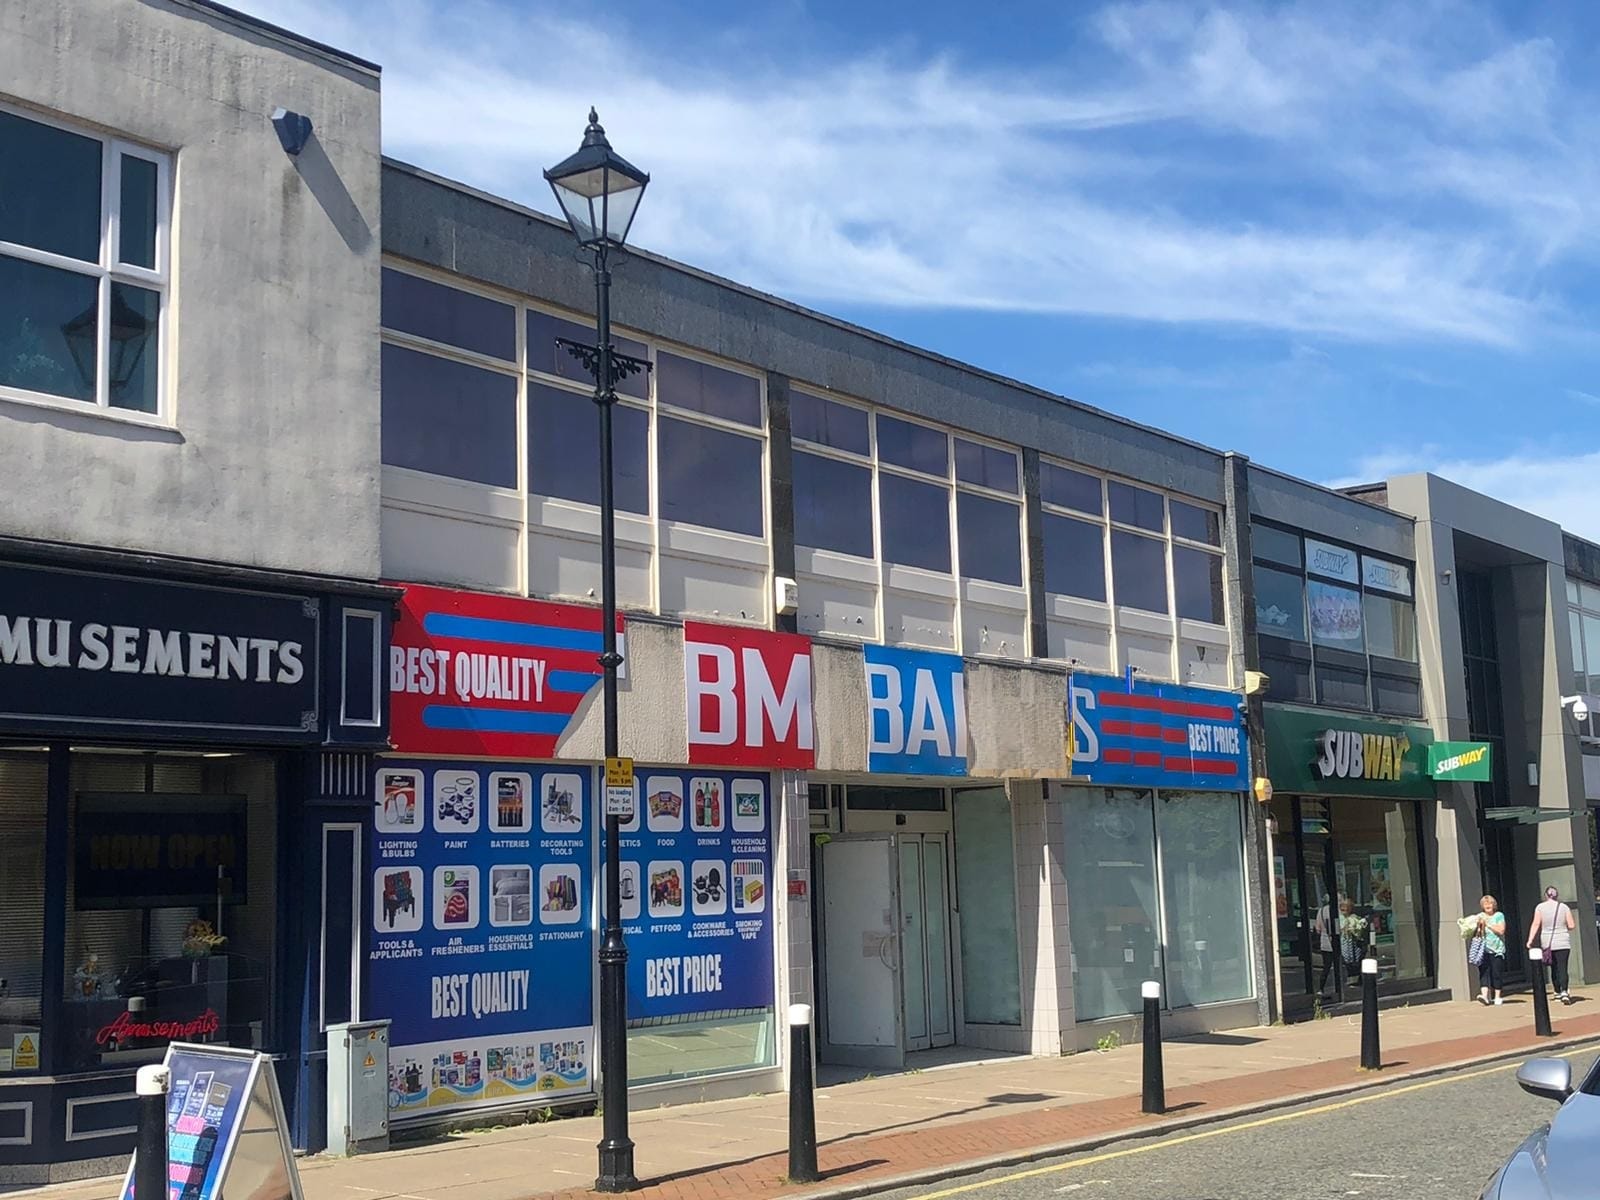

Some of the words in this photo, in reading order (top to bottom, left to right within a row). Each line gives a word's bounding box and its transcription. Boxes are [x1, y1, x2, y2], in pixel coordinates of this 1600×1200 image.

[1314, 549, 1349, 575] SUBWAY
[390, 646, 450, 696] BEST
[455, 651, 546, 702] QUALITY
[1188, 723, 1214, 753] BEST
[1214, 727, 1240, 755] PRICE
[1318, 729, 1410, 781] SUBWAY
[1435, 746, 1487, 775] SUBWAY
[379, 841, 418, 849] LIGHTING
[444, 840, 468, 849] PAINT
[490, 840, 530, 848] BATTERIES
[540, 840, 584, 848] DECORATING
[657, 838, 675, 847] FOOD
[697, 838, 721, 846] DRINKS
[731, 838, 767, 846] HOUSEHOLD
[550, 848, 573, 856] TOOLS
[650, 924, 664, 933] PET
[664, 923, 682, 932] FOOD
[692, 921, 726, 930] COOKWARE
[735, 920, 763, 928] SMOKING
[539, 931, 584, 940] STATIONARY
[693, 928, 734, 938] ACCESSORIES
[741, 931, 757, 940] VAPE
[448, 937, 463, 945] AIR
[488, 934, 533, 943] HOUSEHOLD
[378, 940, 407, 950] TOOLS
[488, 941, 533, 951] ESSENTIALS
[369, 948, 423, 960] APPLICANTS
[431, 944, 485, 956] FRESHENERS
[646, 956, 681, 998] BEST
[683, 953, 722, 994] PRICE
[431, 974, 469, 1019] BEST
[471, 969, 530, 1019] QUALITY
[96, 1008, 219, 1045] Amusements
[369, 1031, 376, 1039] 2
